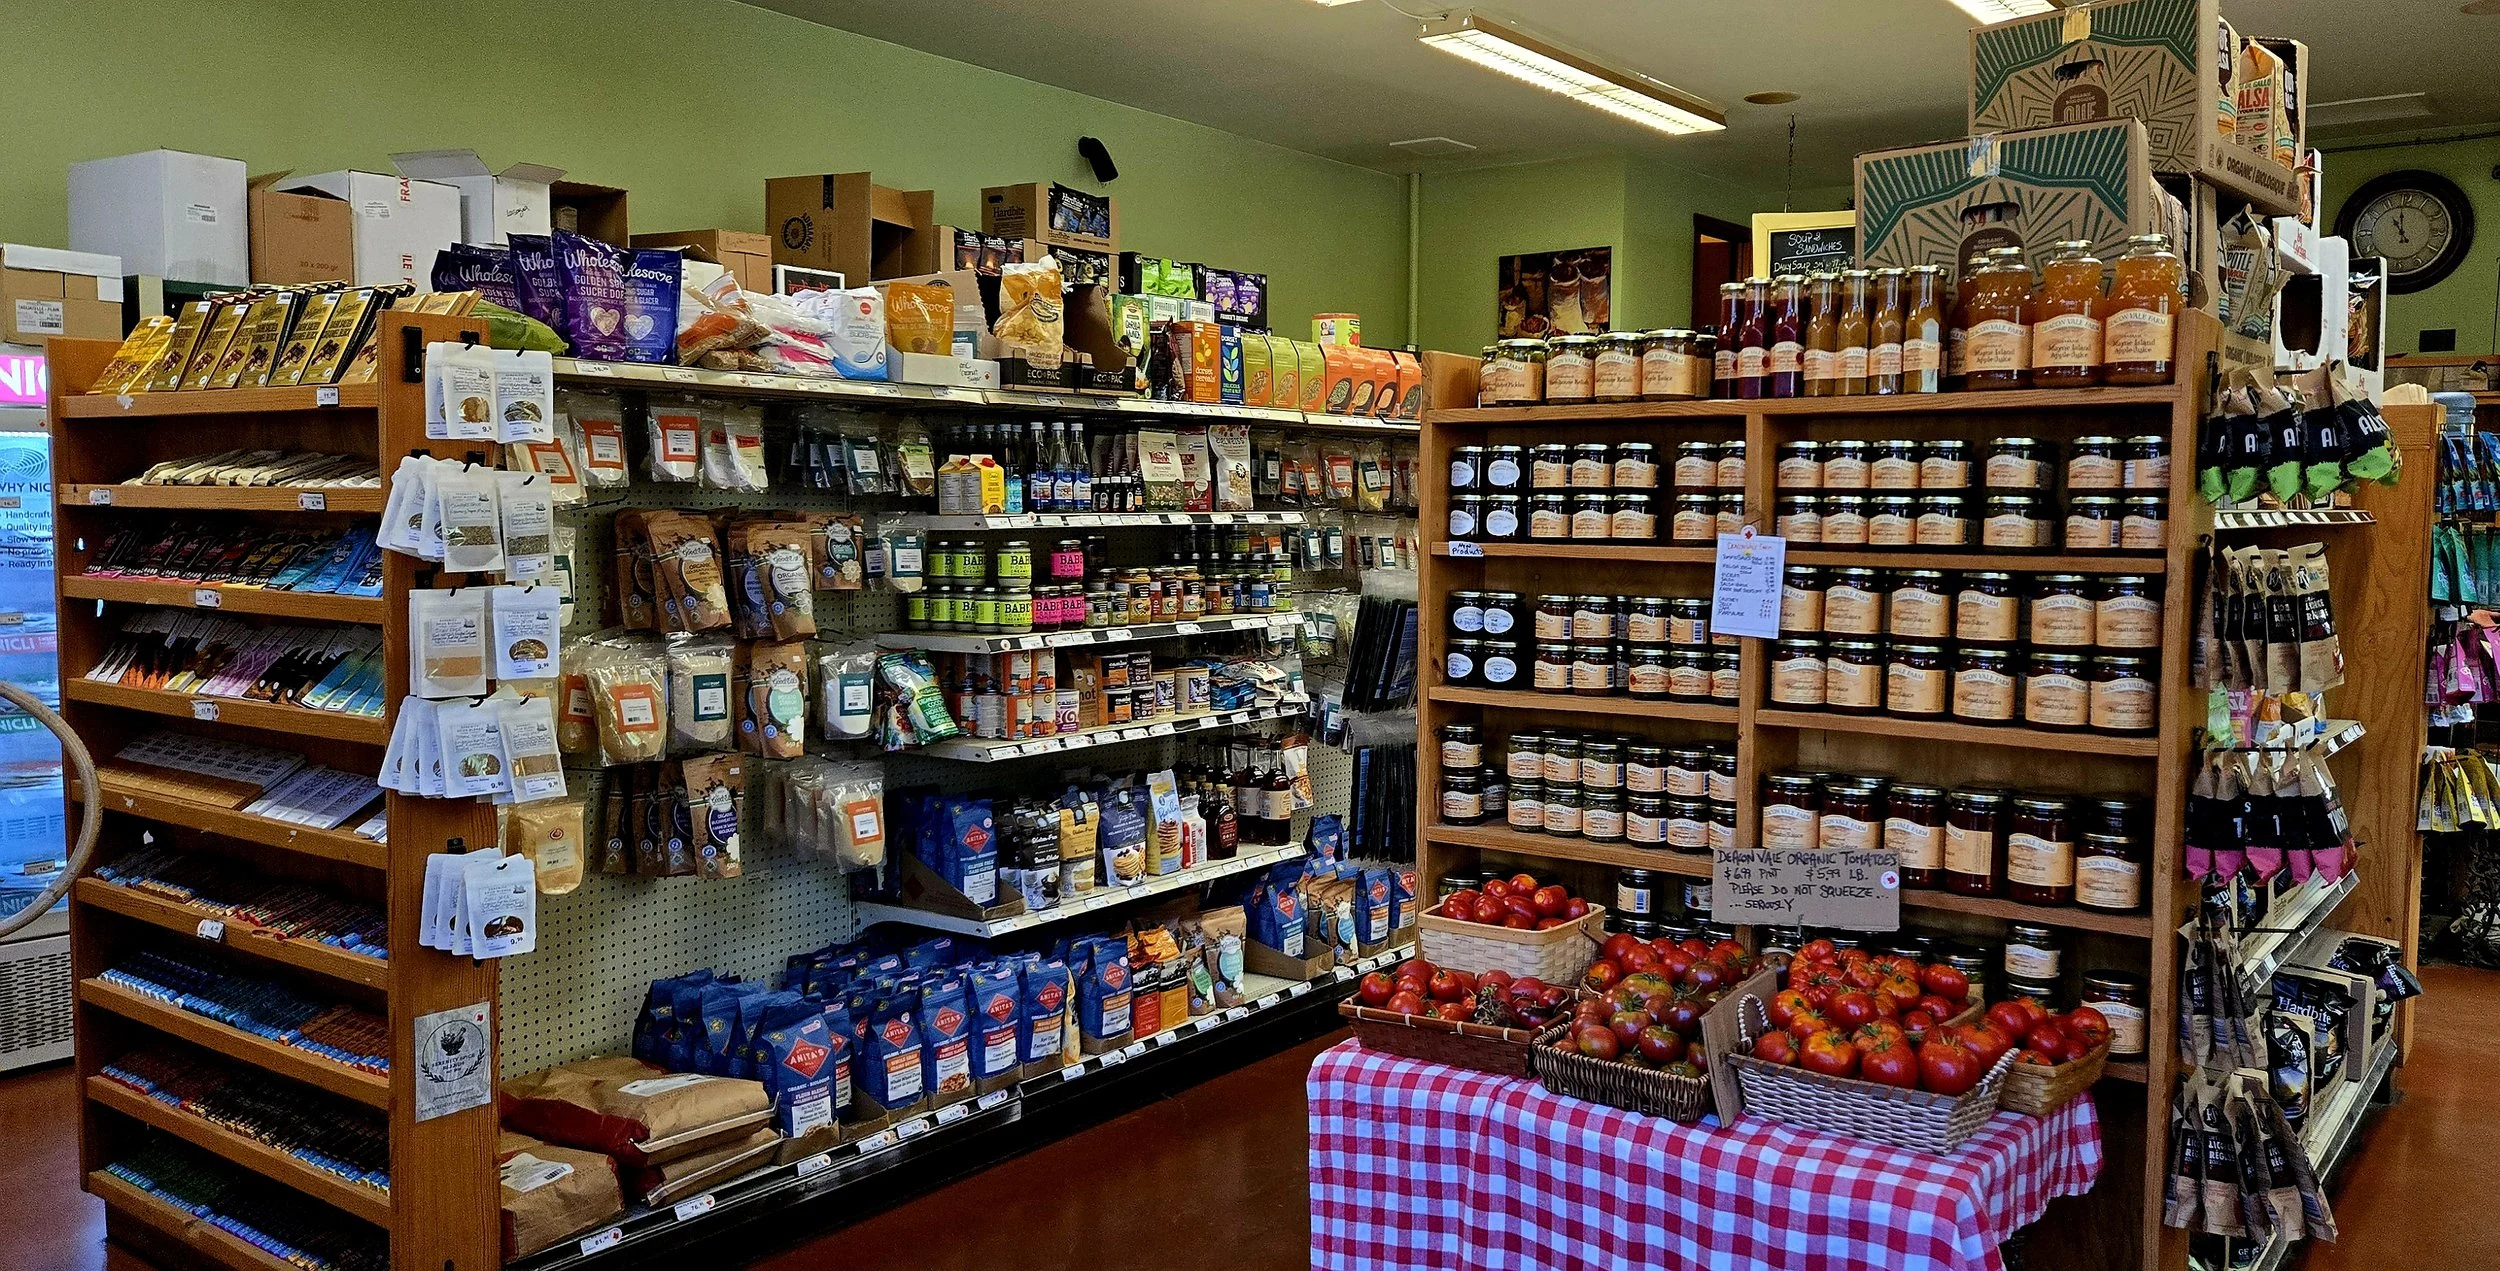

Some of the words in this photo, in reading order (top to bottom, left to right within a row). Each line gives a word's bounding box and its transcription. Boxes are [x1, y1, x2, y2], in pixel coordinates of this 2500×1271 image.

[2238, 87, 2270, 107] ALSA
[993, 206, 1026, 218] Hardbite
[1788, 232, 1812, 246] SOUP
[1796, 241, 1843, 256] SANDWICHES
[2227, 253, 2254, 272] POTLE
[575, 274, 608, 287] GOLDEN
[610, 279, 625, 290] SUG
[580, 286, 608, 298] SUCRE
[2066, 318, 2082, 327] VALE
[1990, 324, 2006, 334] VALE
[2007, 326, 2024, 336] FARM
[2072, 343, 2091, 352] Island
[2134, 338, 2156, 346] Island
[1668, 354, 1684, 365] FARM
[6, 523, 38, 532] Quality
[1452, 548, 1484, 557] Products
[8, 560, 36, 569] Ready
[1788, 588, 1806, 600] FARM
[1840, 588, 1854, 598] VALE
[1854, 590, 1870, 602] FARM
[1910, 590, 1924, 600] VALE
[1924, 594, 1940, 605] FARM
[1965, 594, 1980, 604] VALE
[1981, 598, 2000, 608] FARM
[2127, 600, 2142, 608] VALE
[1802, 660, 1816, 670] VALE
[1907, 670, 1924, 680] FARM
[1979, 674, 1994, 682] VALE
[1994, 676, 2010, 686] FARM
[2054, 678, 2070, 686] VALE
[2071, 682, 2087, 691] FARM
[2127, 682, 2142, 690] VALE
[1836, 819, 1849, 828] VALE
[1850, 822, 1867, 832] FARM
[1898, 822, 1912, 832] VALE
[1912, 826, 1928, 837] FARM
[966, 834, 987, 843] ANITA'S
[2022, 838, 2036, 848] VALE
[2037, 842, 2054, 852] FARM
[1716, 850, 1755, 865] DEACON
[1756, 850, 1786, 866] VALE
[1787, 852, 1837, 871] ORGANIC
[1839, 851, 1898, 867] TOMATOES
[1850, 869, 1870, 882] LB.
[1729, 882, 1765, 895] PLEASE
[1771, 885, 1788, 896] DO
[1794, 884, 1817, 896] NOT
[1106, 970, 1126, 982] ANITA'S
[2386, 964, 2406, 996] Hardbite
[1038, 991, 1062, 1002] ANITA'S
[990, 1002, 1014, 1014] ANITA'S
[2112, 1006, 2128, 1016] VALE
[2276, 997, 2332, 1026] Hardbite
[936, 1014, 961, 1026] ANITA'S
[886, 1026, 909, 1038] ANITA'S
[790, 1048, 825, 1065] ANITA'S
[788, 1084, 807, 1092] ORGANIC
[796, 1090, 811, 1100] FLOUR
